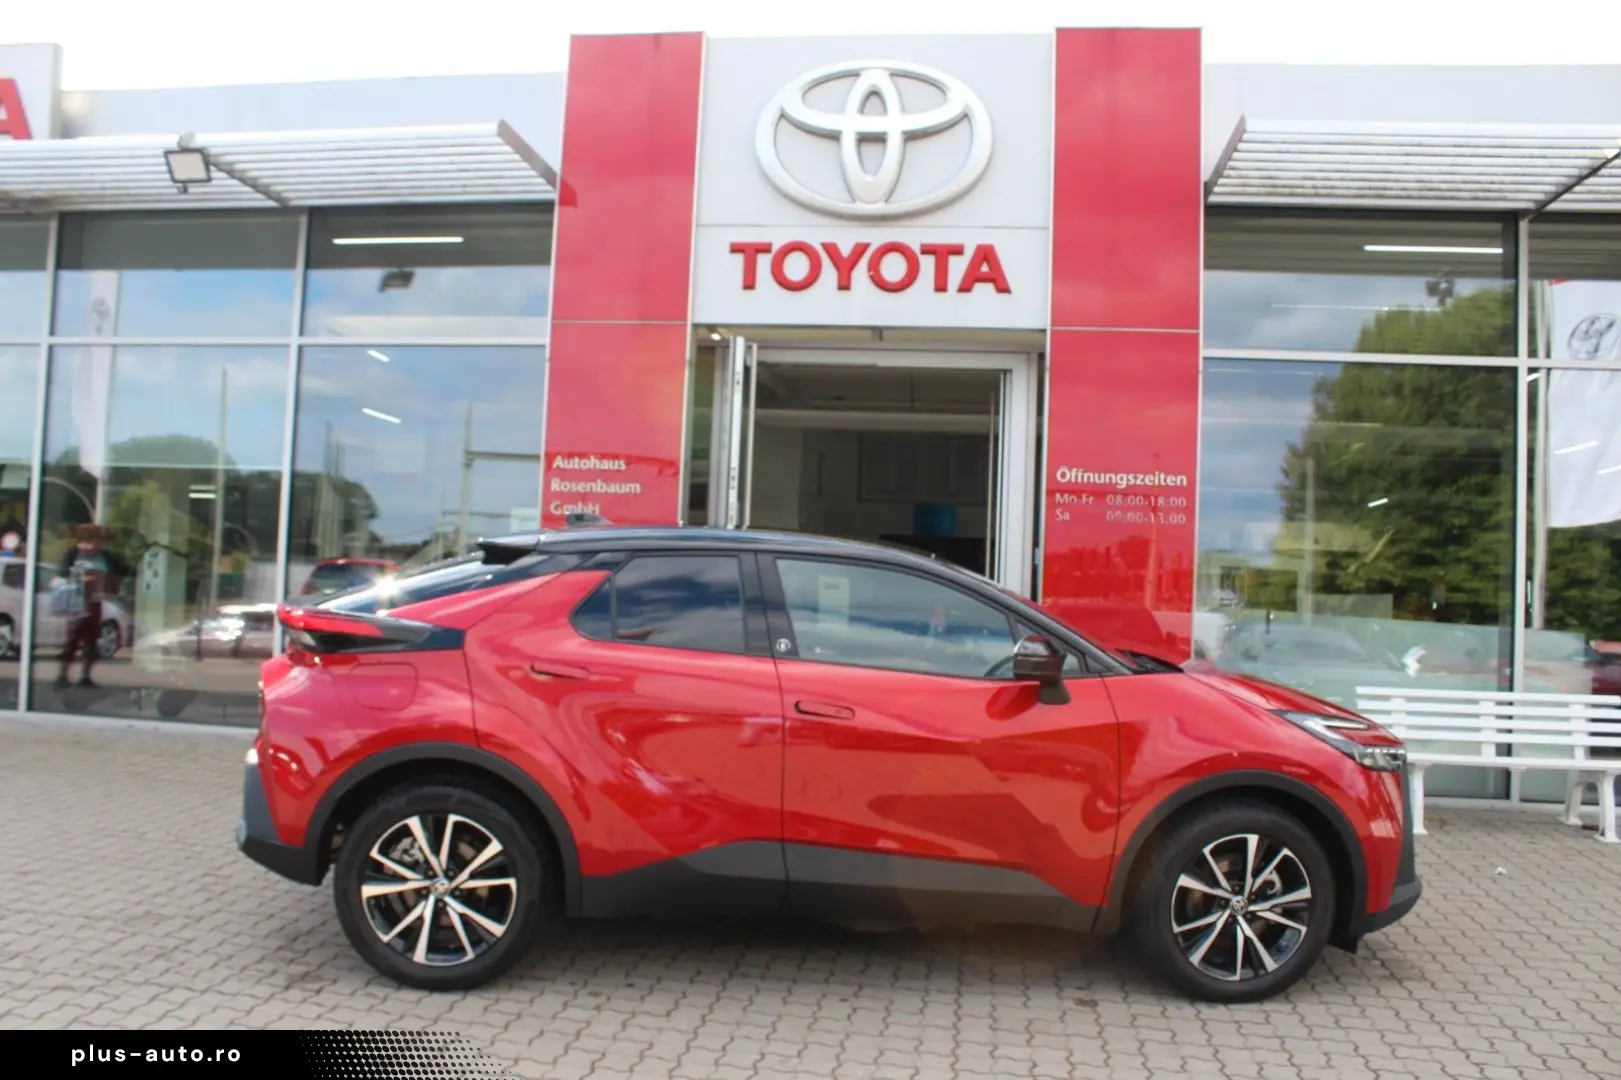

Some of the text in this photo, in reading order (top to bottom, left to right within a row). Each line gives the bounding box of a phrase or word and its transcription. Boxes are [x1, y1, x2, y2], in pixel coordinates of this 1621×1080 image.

[729, 240, 1012, 294] TOYOTA
[553, 455, 626, 470] Autohaus
[1056, 466, 1188, 488] Öffnungszeiten
[550, 478, 641, 494] Rosenbaum
[1055, 508, 1070, 521] Sa
